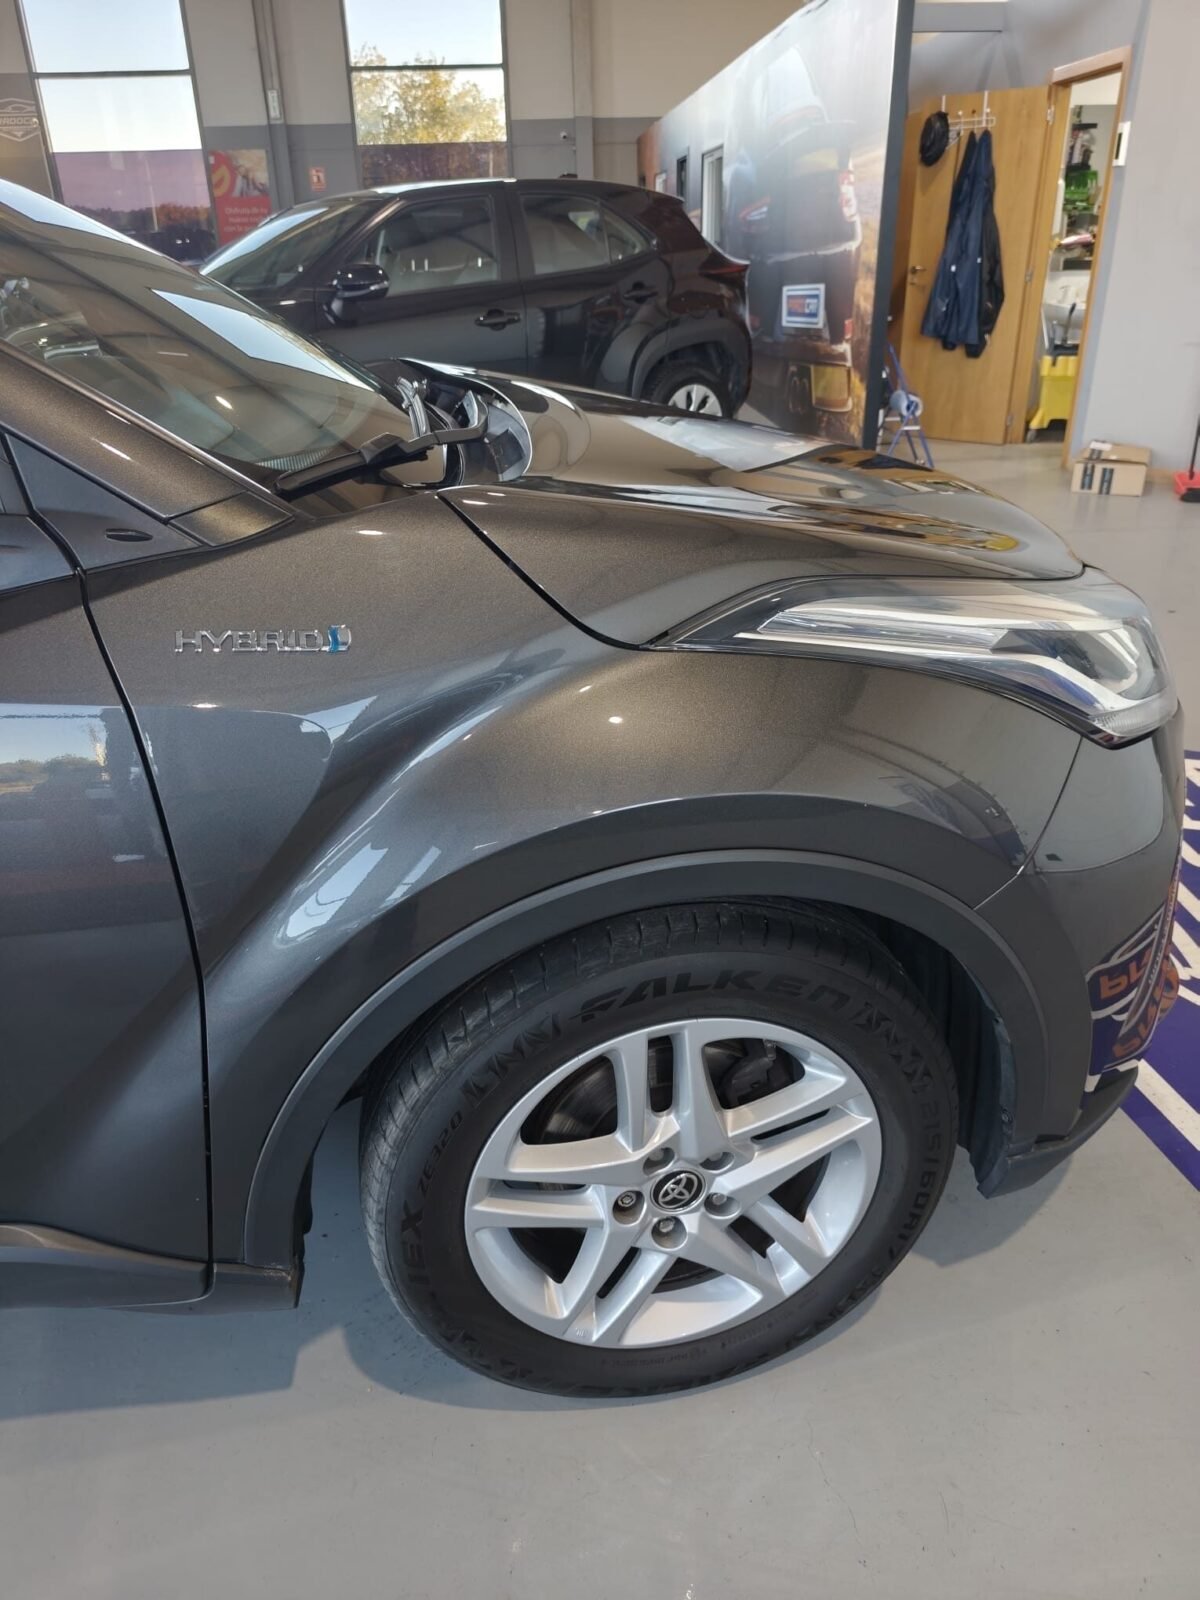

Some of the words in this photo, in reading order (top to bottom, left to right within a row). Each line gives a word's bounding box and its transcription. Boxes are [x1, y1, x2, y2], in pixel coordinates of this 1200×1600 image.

[174, 630, 324, 652] HYBRID
[569, 969, 851, 1024] FALKEN
[416, 1111, 464, 1196] ZE320
